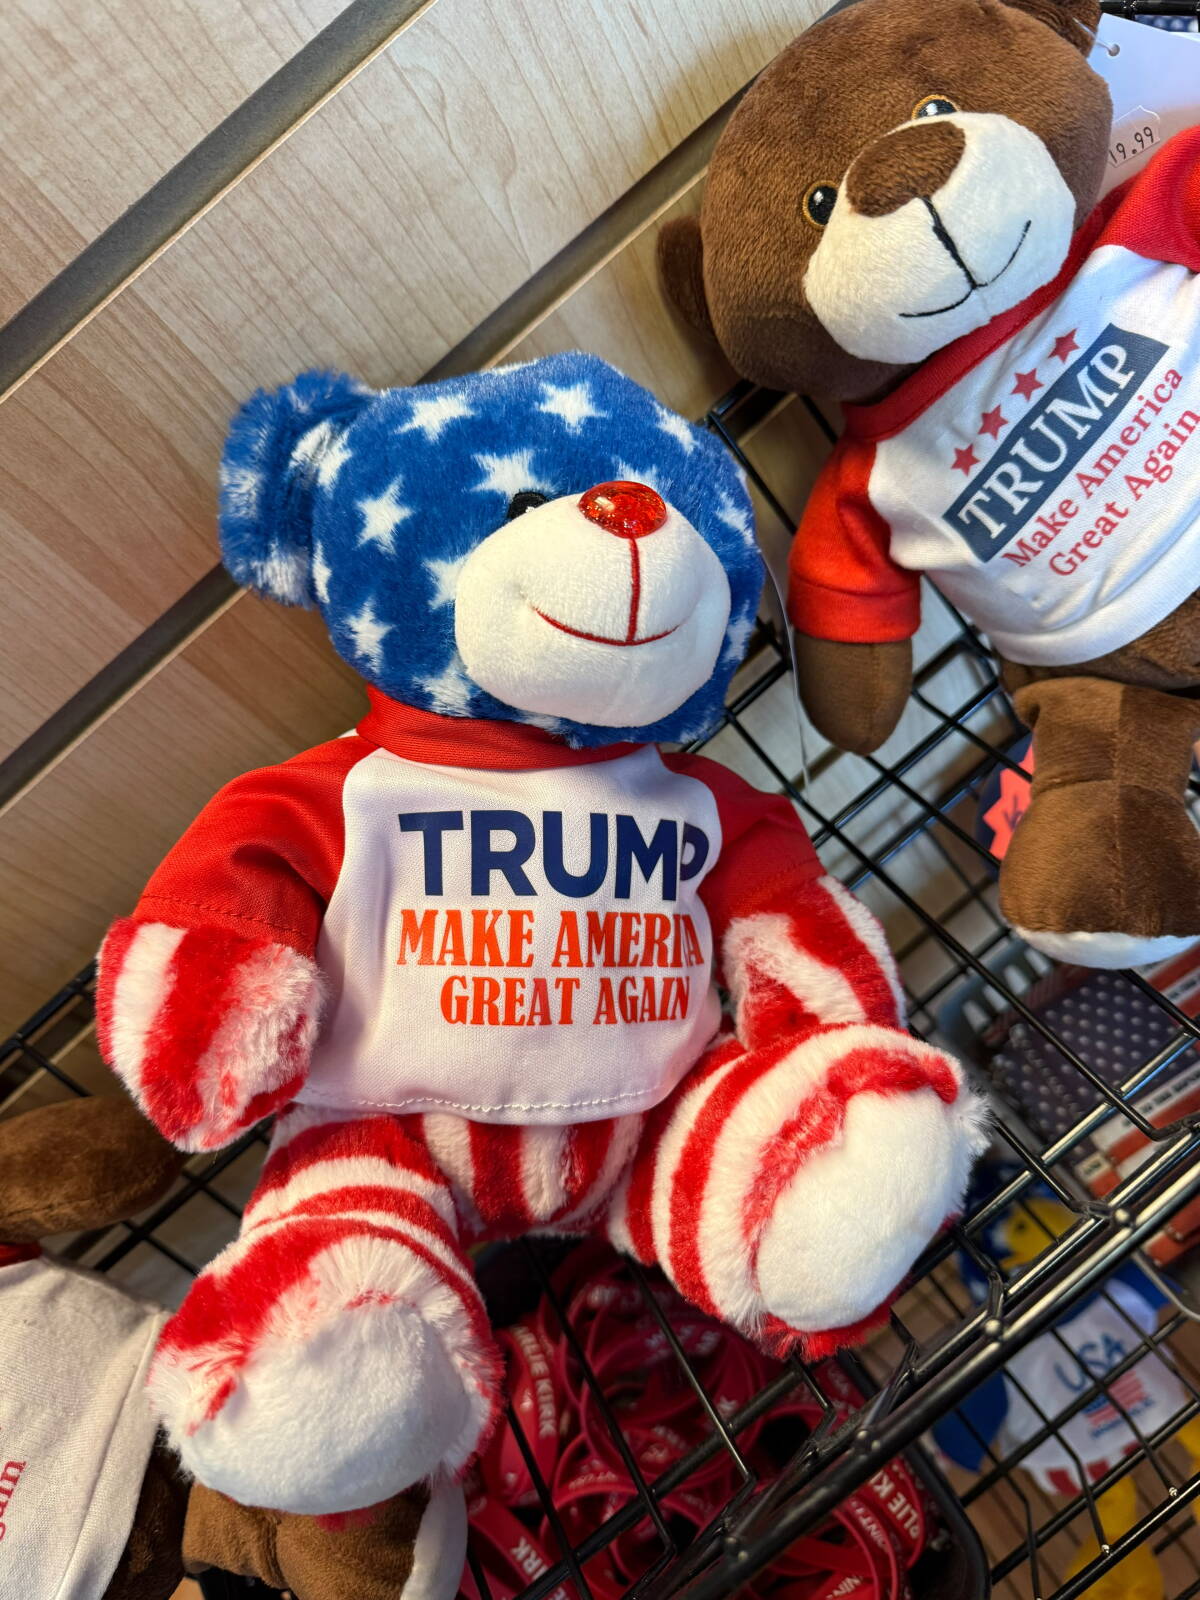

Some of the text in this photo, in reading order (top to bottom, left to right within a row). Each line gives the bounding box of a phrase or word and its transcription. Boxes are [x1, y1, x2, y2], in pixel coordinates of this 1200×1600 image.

[958, 344, 1135, 539] TRUMP
[1002, 368, 1183, 567] Make America
[1049, 410, 1200, 576] Great Again
[397, 909, 705, 968] MAKE AMERIA
[440, 976, 692, 1026] GREAT AGAIN
[535, 1378, 556, 1439] KIRK
[868, 1469, 895, 1498] KI
[510, 1536, 549, 1581] IRK
